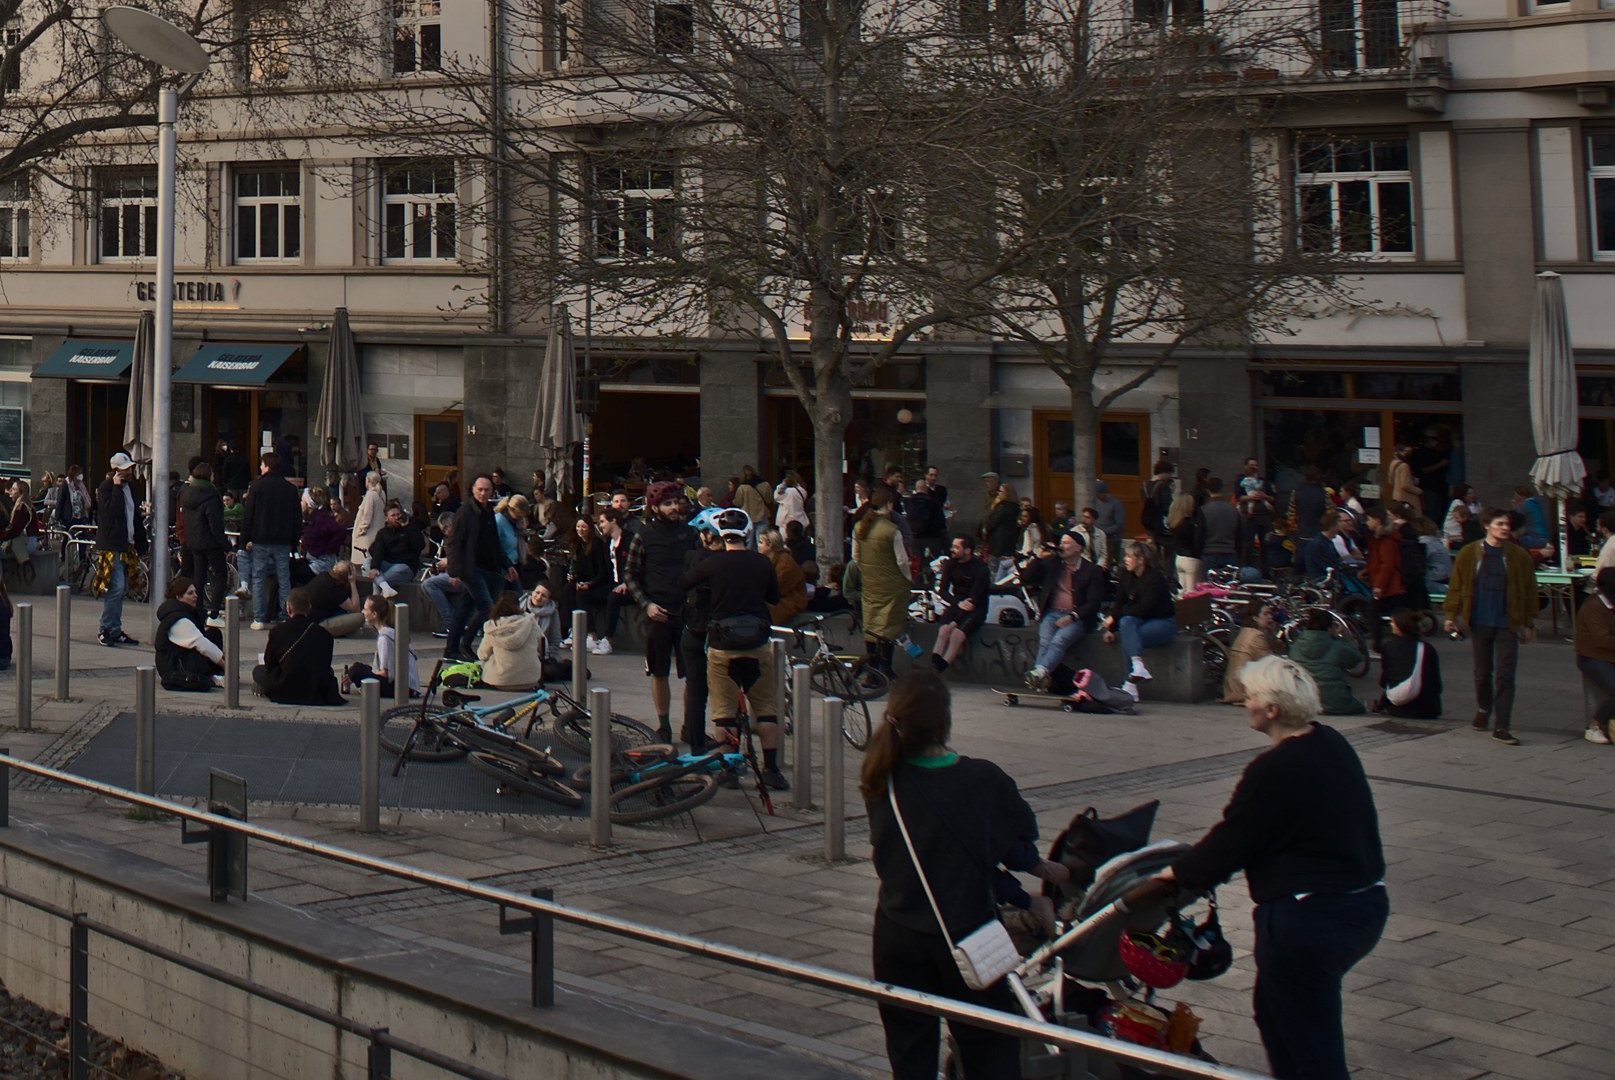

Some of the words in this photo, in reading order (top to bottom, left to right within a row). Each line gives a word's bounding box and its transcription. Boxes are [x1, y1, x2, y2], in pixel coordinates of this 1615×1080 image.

[136, 281, 224, 301] GETERIA
[69, 355, 117, 365] KAISERBAU
[207, 360, 260, 370] KAISERBAU
[467, 425, 477, 435] 14
[1185, 428, 1198, 439] 12
